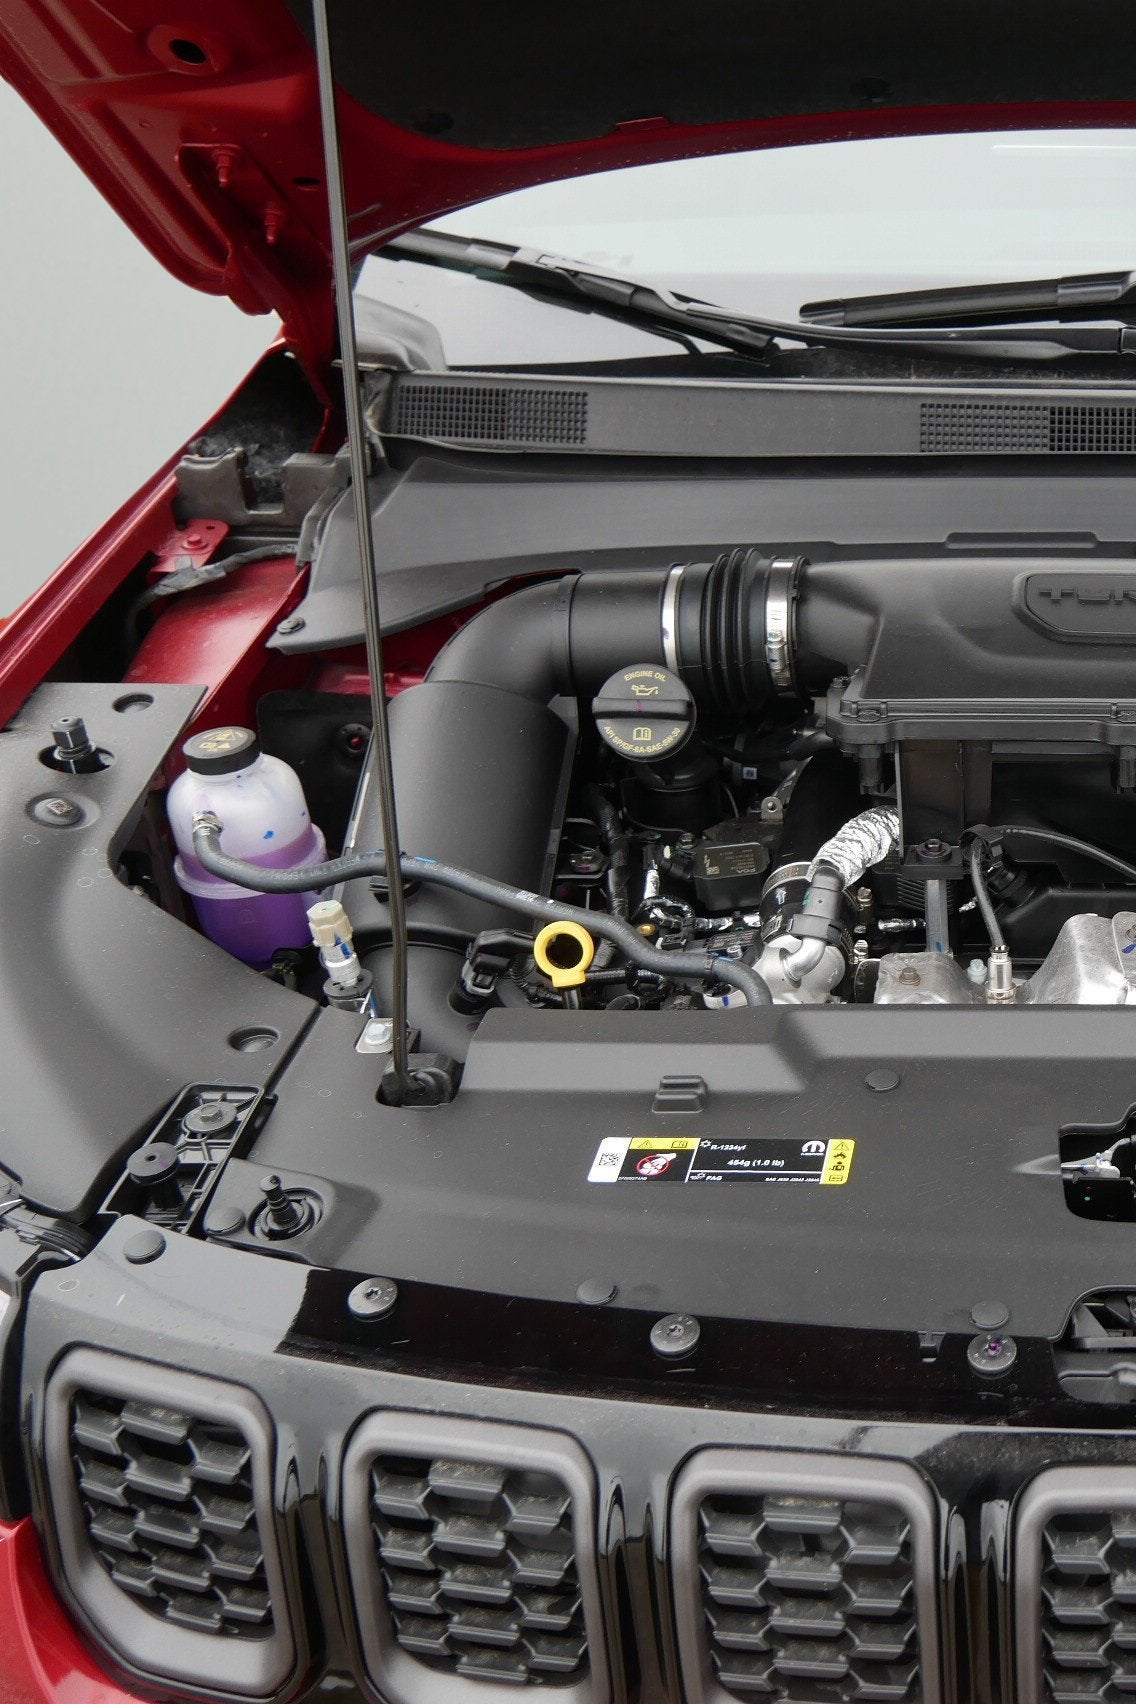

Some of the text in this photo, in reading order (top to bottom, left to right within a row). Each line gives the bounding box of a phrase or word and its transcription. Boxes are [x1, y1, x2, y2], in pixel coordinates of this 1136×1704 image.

[624, 670, 666, 682] ENGINE OIL
[603, 726, 615, 739] API
[710, 1143, 747, 1152] R-1234yf
[727, 1159, 785, 1168] 454g (1.0 lb)
